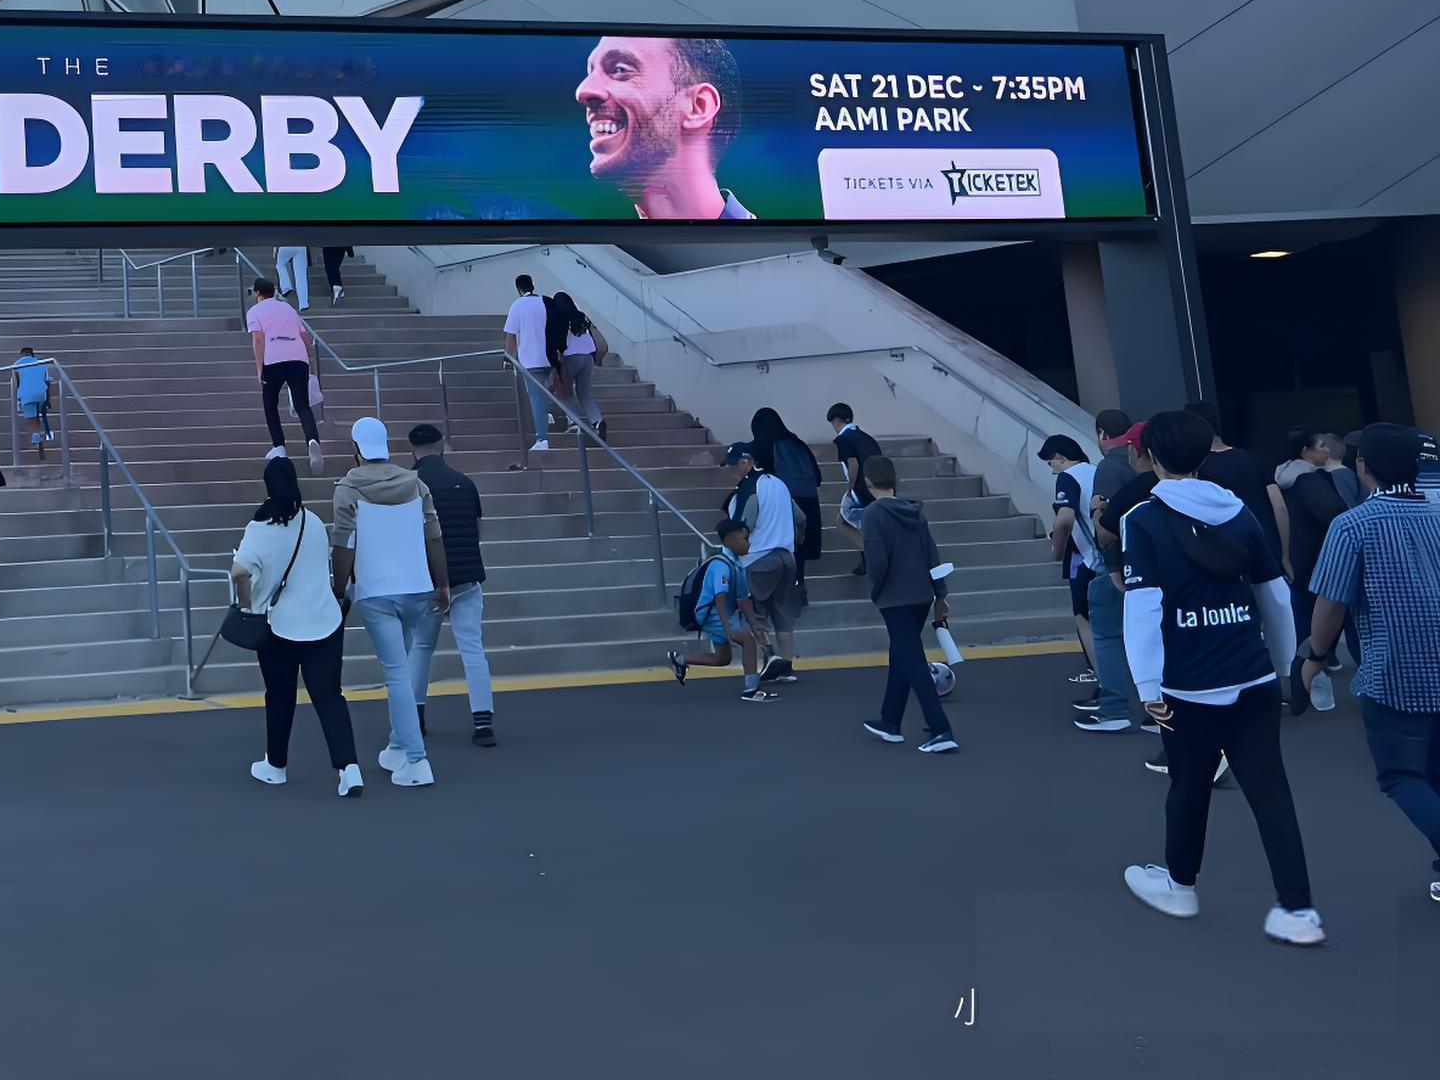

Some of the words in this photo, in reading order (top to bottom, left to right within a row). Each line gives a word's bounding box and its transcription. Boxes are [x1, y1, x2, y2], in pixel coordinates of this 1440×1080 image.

[37, 57, 110, 76] THE
[809, 73, 862, 99] SAT
[871, 74, 899, 99] 21
[907, 75, 965, 99] DEC
[991, 75, 1087, 101] 7:35PM
[814, 106, 889, 132] AAMI
[896, 107, 973, 133] PARK
[843, 176, 905, 191] TICKETS
[908, 177, 934, 191] VIA
[947, 170, 1038, 194] TICKETEK
[1176, 607, 1198, 628] La
